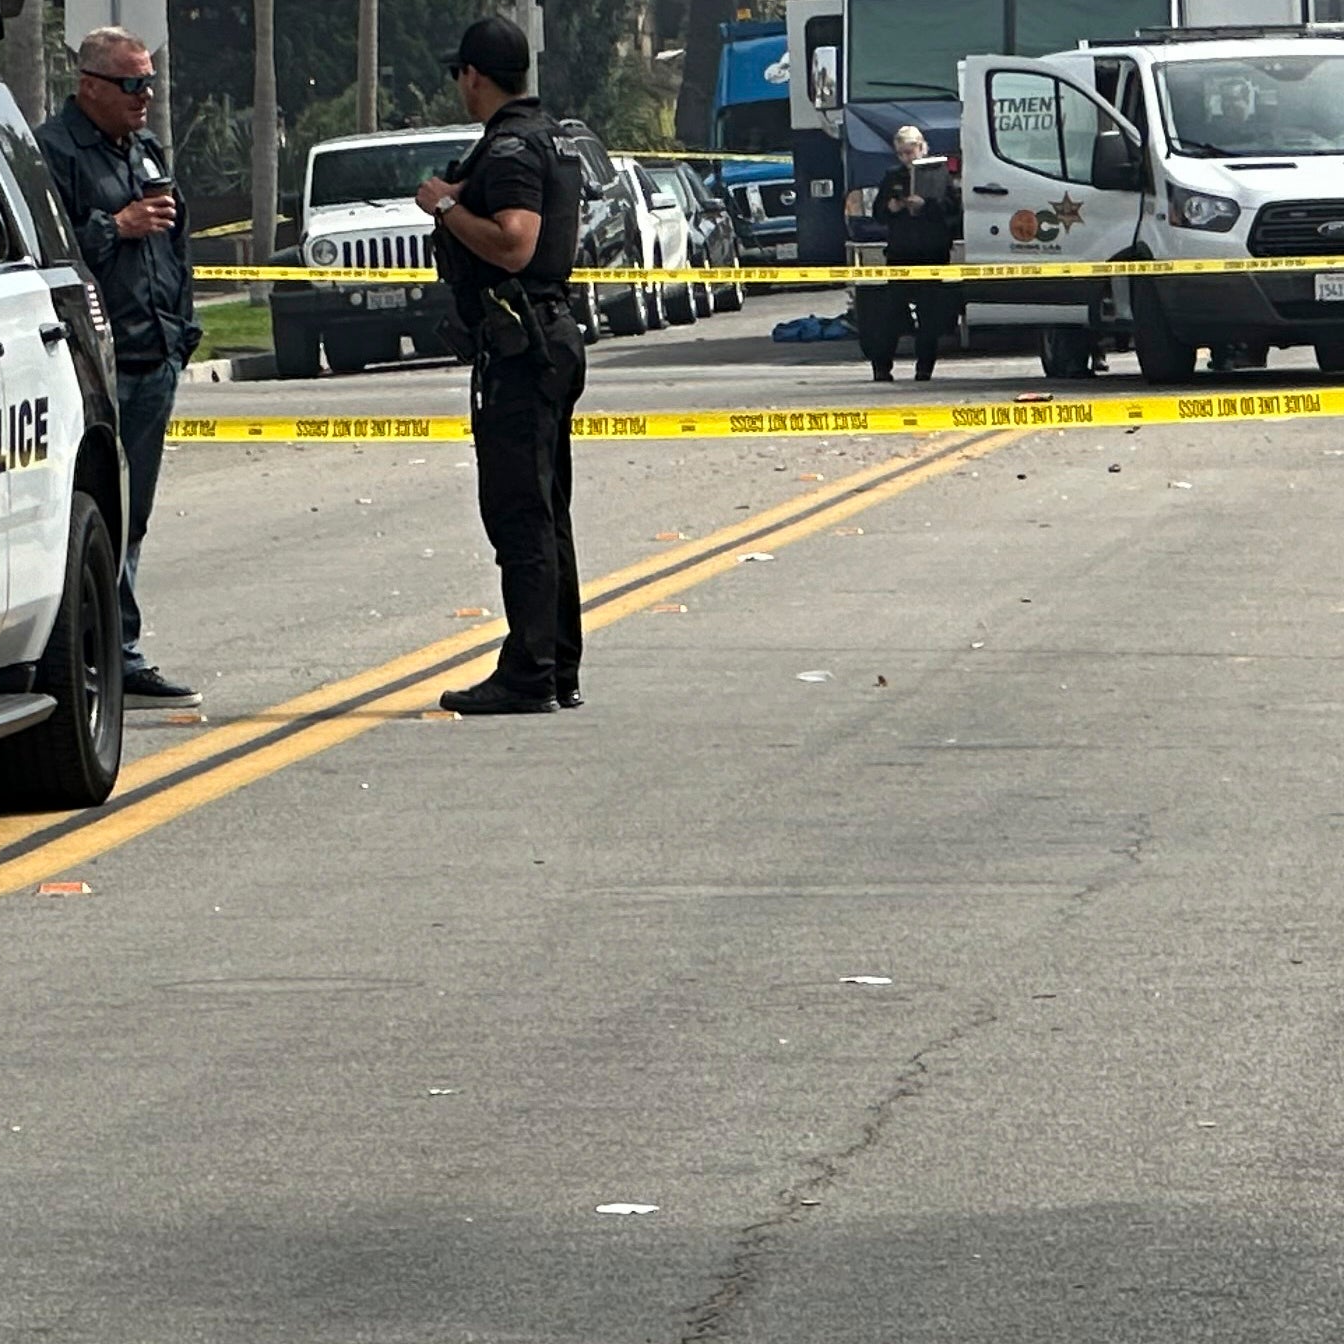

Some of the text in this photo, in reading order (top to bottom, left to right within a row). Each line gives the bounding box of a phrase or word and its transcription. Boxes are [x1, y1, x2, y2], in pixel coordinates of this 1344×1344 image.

[953, 404, 1092, 426] POLICE LINE DO NOT CROSS
[1179, 394, 1320, 418] POLICE LINE DO NOT CROSS
[296, 419, 429, 437] POLICE LINE DO NOT CROSS
[586, 418, 605, 436] LINE
[609, 417, 646, 435] POLICE
[731, 412, 867, 433] POLICE LINE DO NOT CROSS
